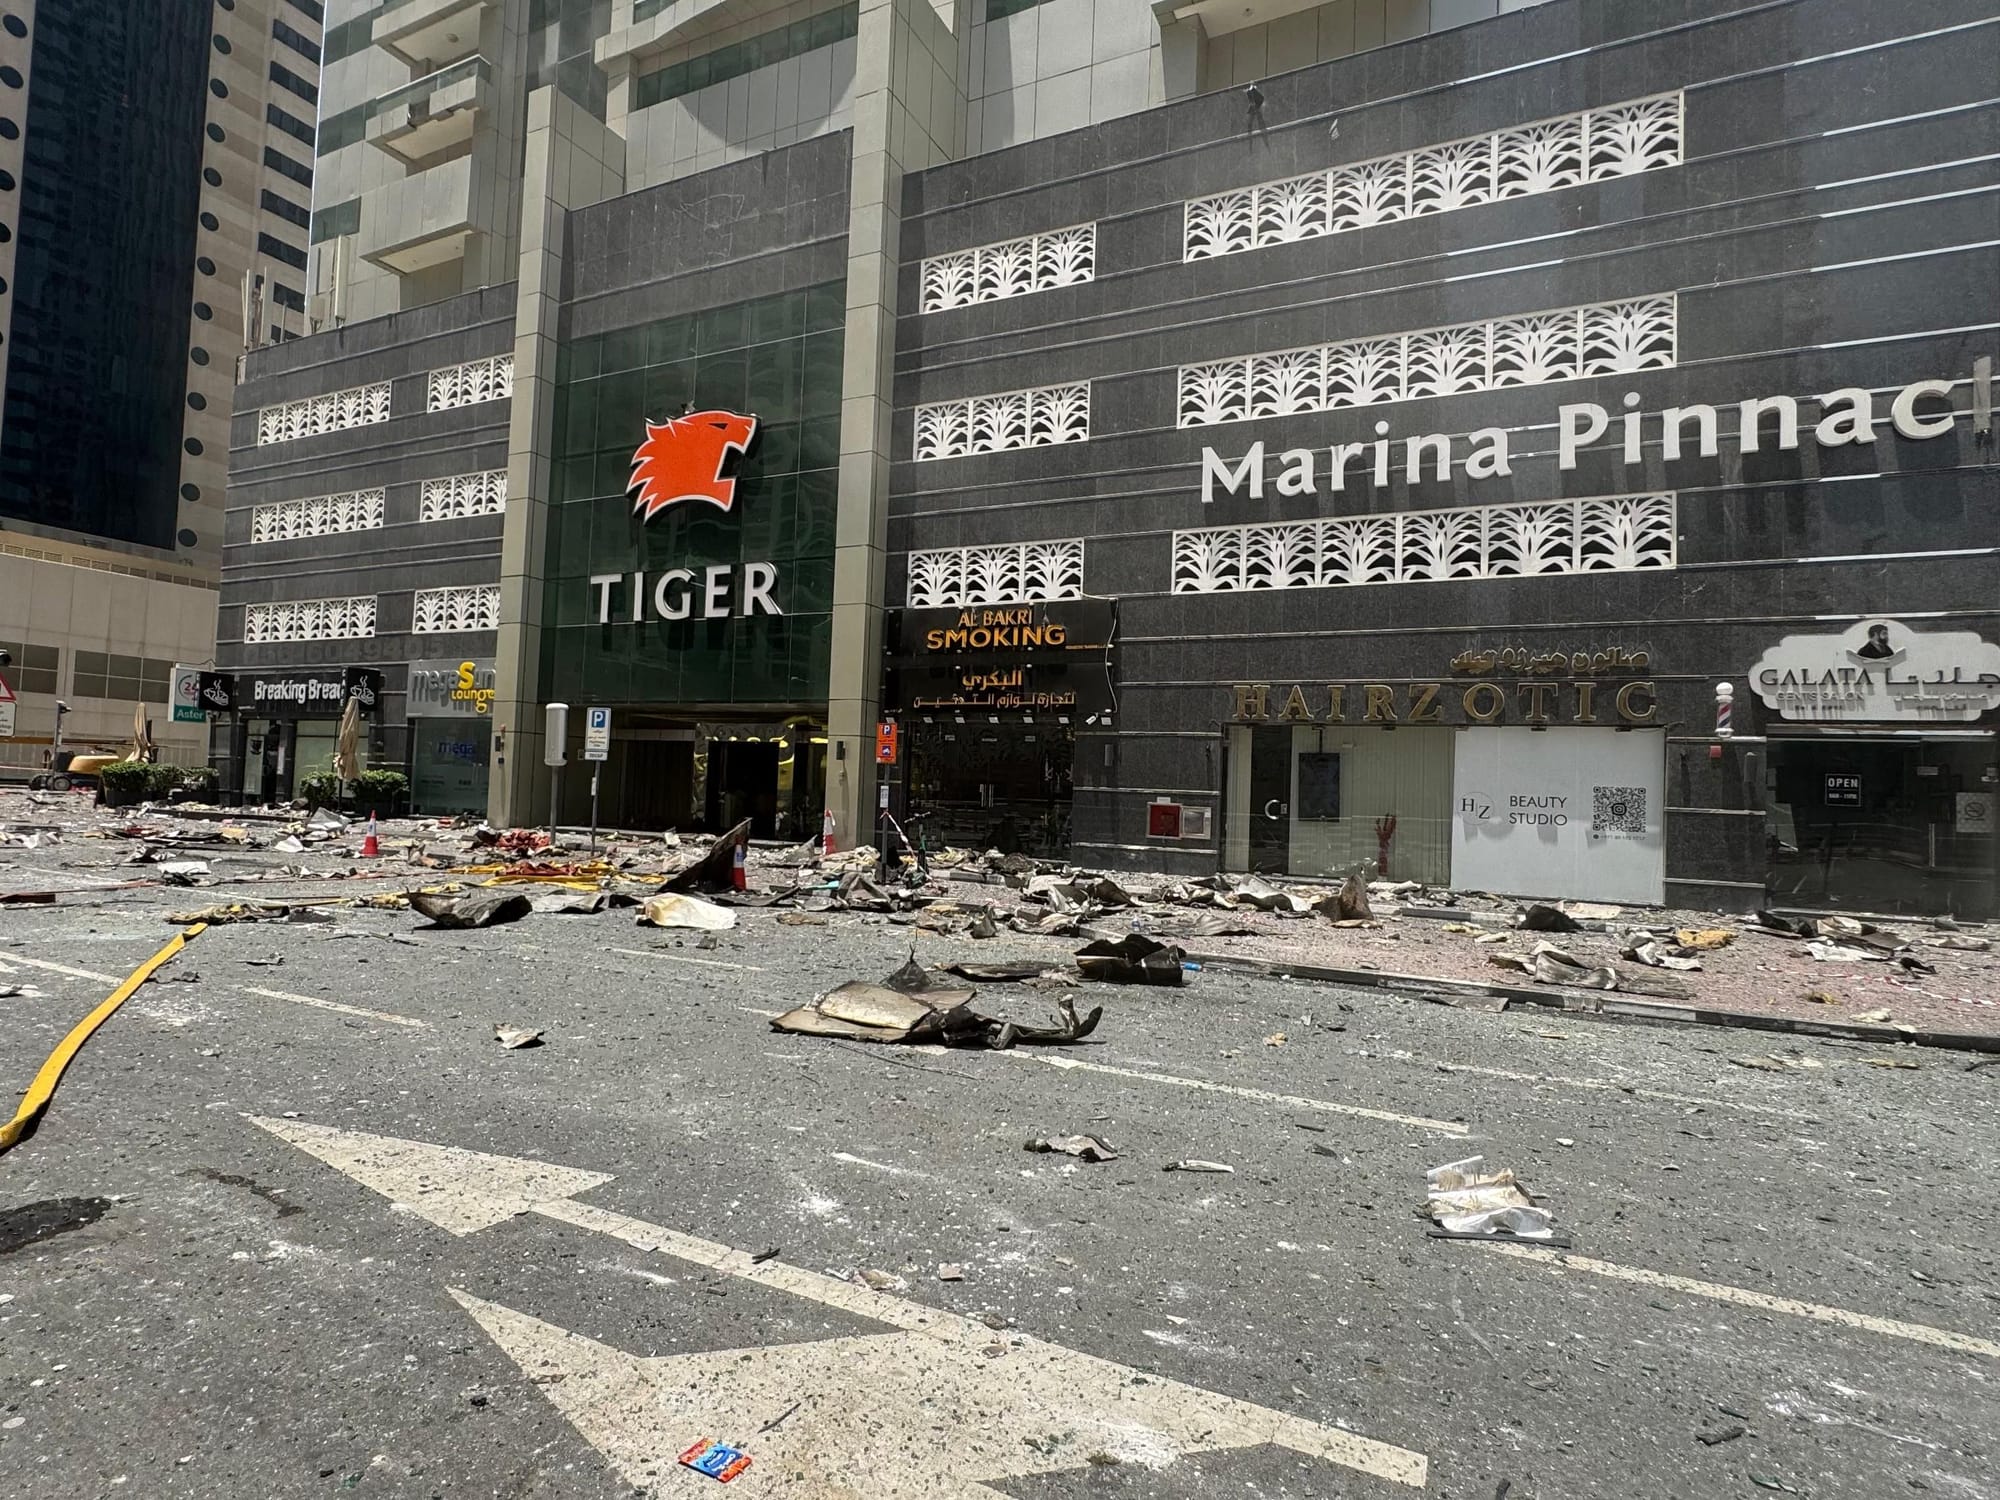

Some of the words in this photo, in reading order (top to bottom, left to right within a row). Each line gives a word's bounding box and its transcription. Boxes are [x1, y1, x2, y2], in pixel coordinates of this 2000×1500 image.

[1201, 420, 1513, 505] Marina
[590, 561, 784, 624] TIGER
[983, 608, 1033, 626] BAKRI
[926, 624, 1065, 649] SMOKING
[962, 670, 1023, 691] البكري
[1759, 667, 1874, 686] GALATA
[254, 680, 308, 704] Breaking
[1232, 681, 1656, 722] HAIRZOTIC
[176, 709, 204, 720] Aster
[593, 711, 604, 727] P
[883, 725, 891, 735] P
[1828, 778, 1858, 788] OPEN
[1509, 795, 1568, 809] BEAUTY
[1509, 812, 1568, 826] STUDIO
